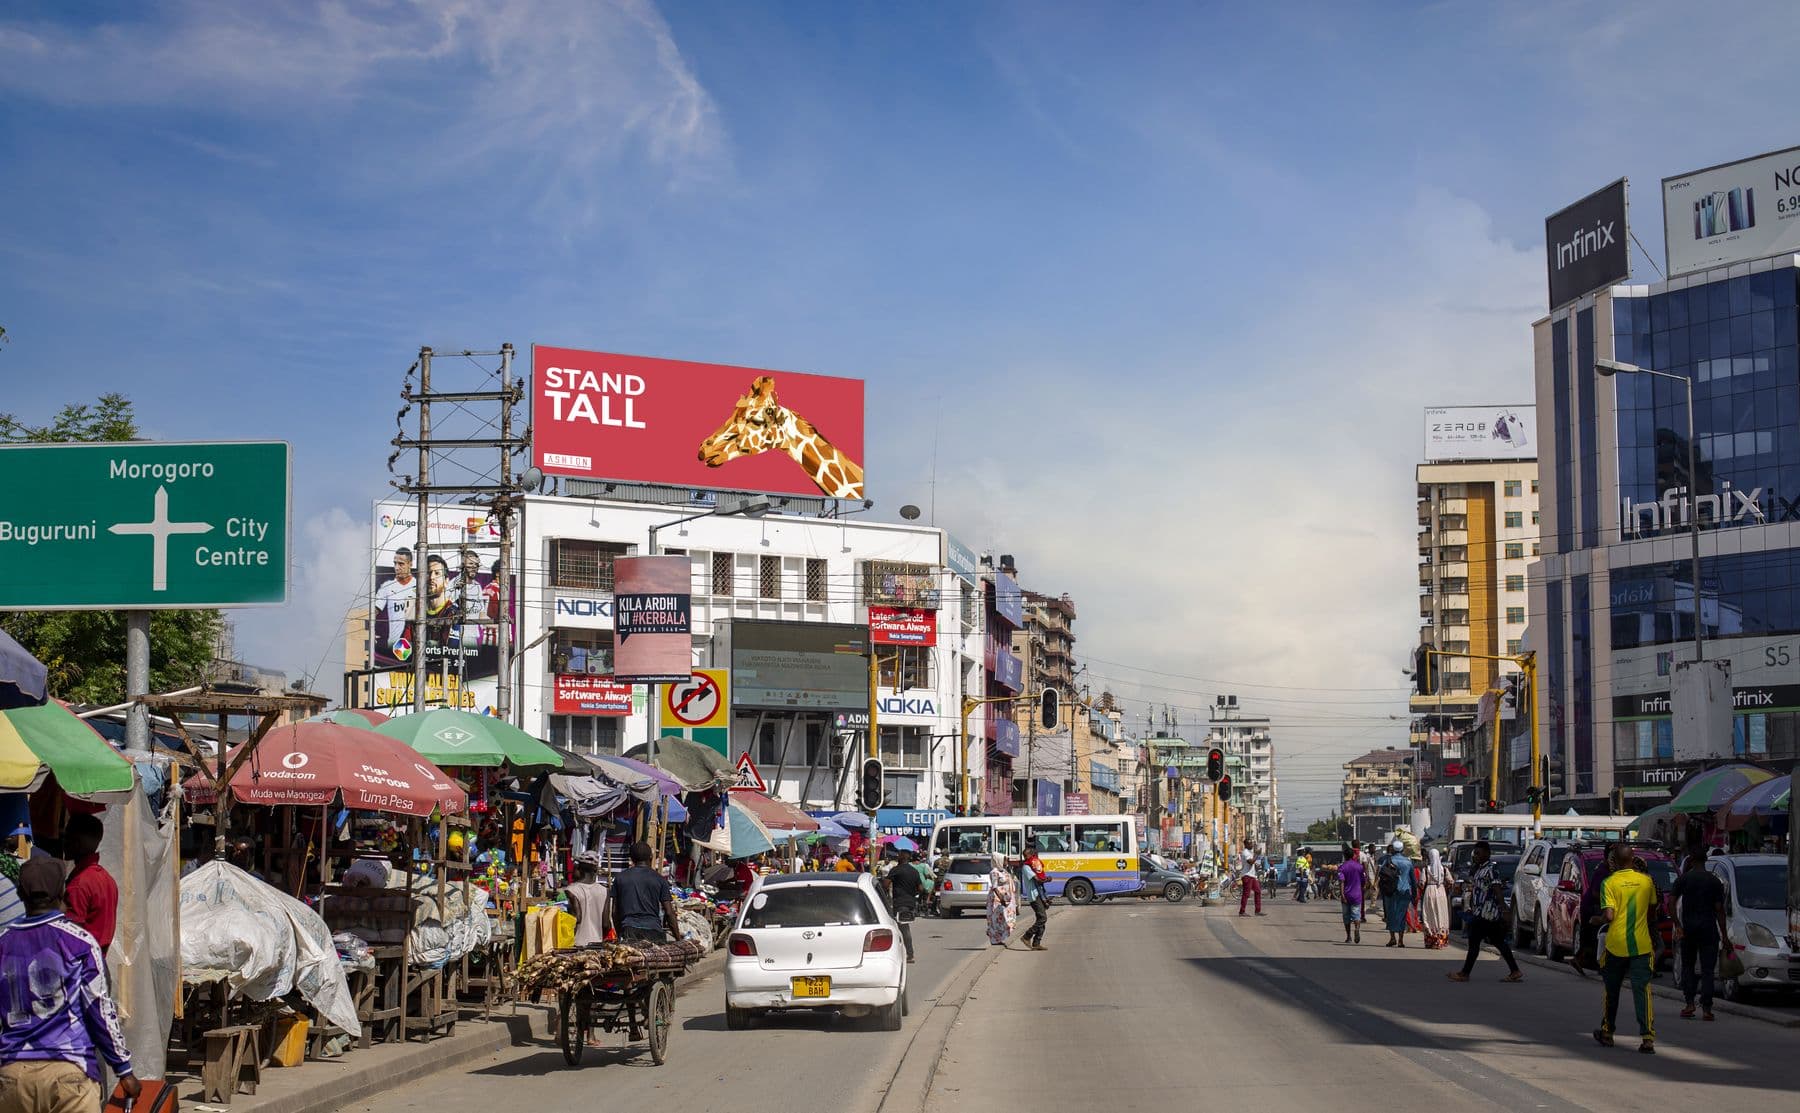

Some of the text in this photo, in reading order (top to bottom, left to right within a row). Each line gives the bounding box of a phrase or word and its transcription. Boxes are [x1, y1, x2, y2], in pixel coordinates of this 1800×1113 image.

[1556, 220, 1616, 270] Infinix
[544, 366, 646, 396] STAND
[544, 390, 647, 429] TALL
[547, 455, 589, 466] ASHTON
[109, 459, 215, 483] Morogoro
[1623, 481, 1765, 533] Infinix
[0, 520, 97, 545] Buguruni
[225, 517, 269, 542] City
[195, 546, 270, 566] Centre
[557, 598, 614, 617] NOKI
[619, 596, 677, 611] KILA ARDHI
[619, 611, 687, 625] NI #KERBALA
[876, 697, 936, 714] NOKIA
[1641, 697, 1672, 713] Infin
[262, 770, 316, 780] vodacom
[361, 764, 389, 776] Piga
[250, 789, 326, 800] Muda wa Maongezi
[359, 789, 414, 811] Tuma Pesa
